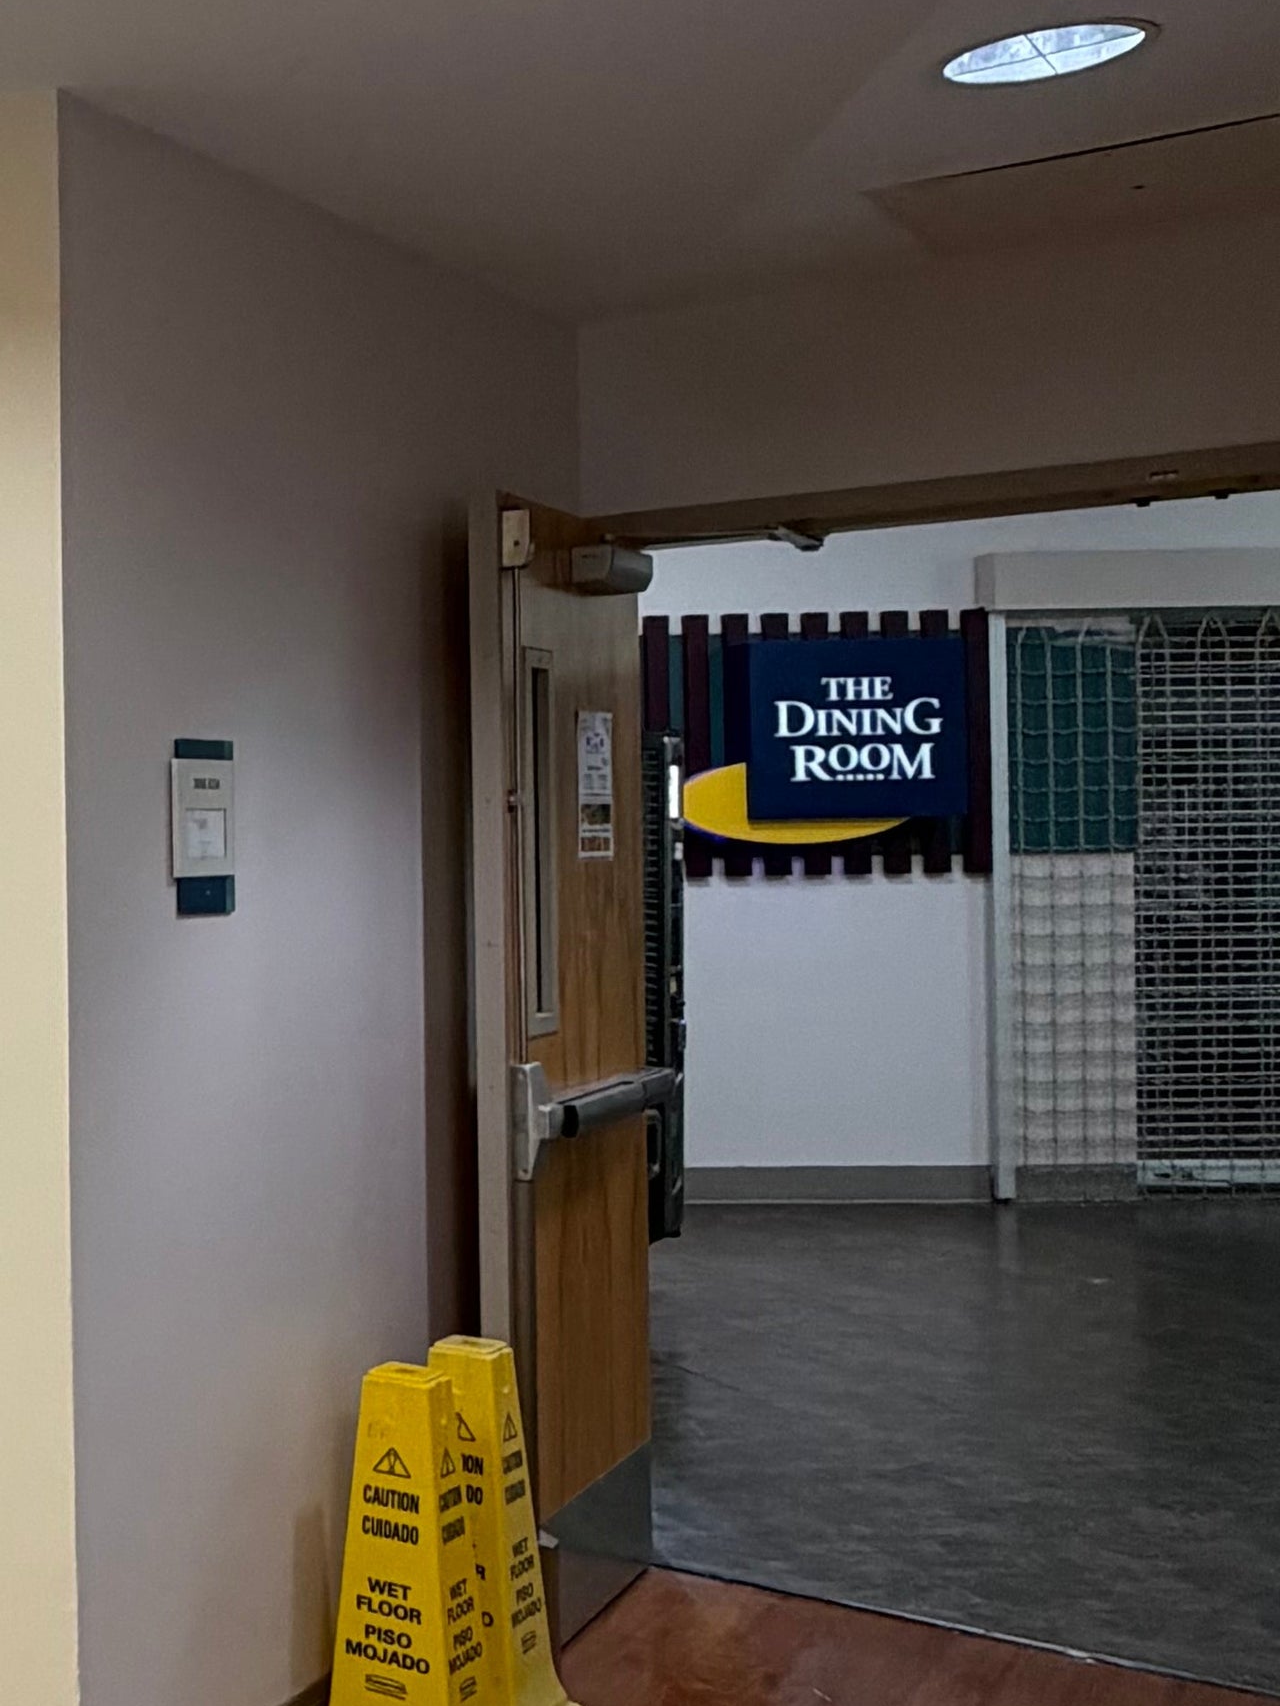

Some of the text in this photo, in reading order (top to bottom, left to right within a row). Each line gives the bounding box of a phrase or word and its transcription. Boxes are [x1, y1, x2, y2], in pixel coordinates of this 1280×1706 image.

[820, 676, 894, 701] THE
[773, 697, 944, 737] DINING
[789, 742, 936, 782] ROOM
[363, 1484, 420, 1514] CAUTION
[362, 1515, 419, 1545] CUIDADO
[367, 1576, 412, 1601] WET
[356, 1594, 422, 1625] FLOOR
[365, 1623, 412, 1649] PISO
[345, 1637, 430, 1675] MOJADO
